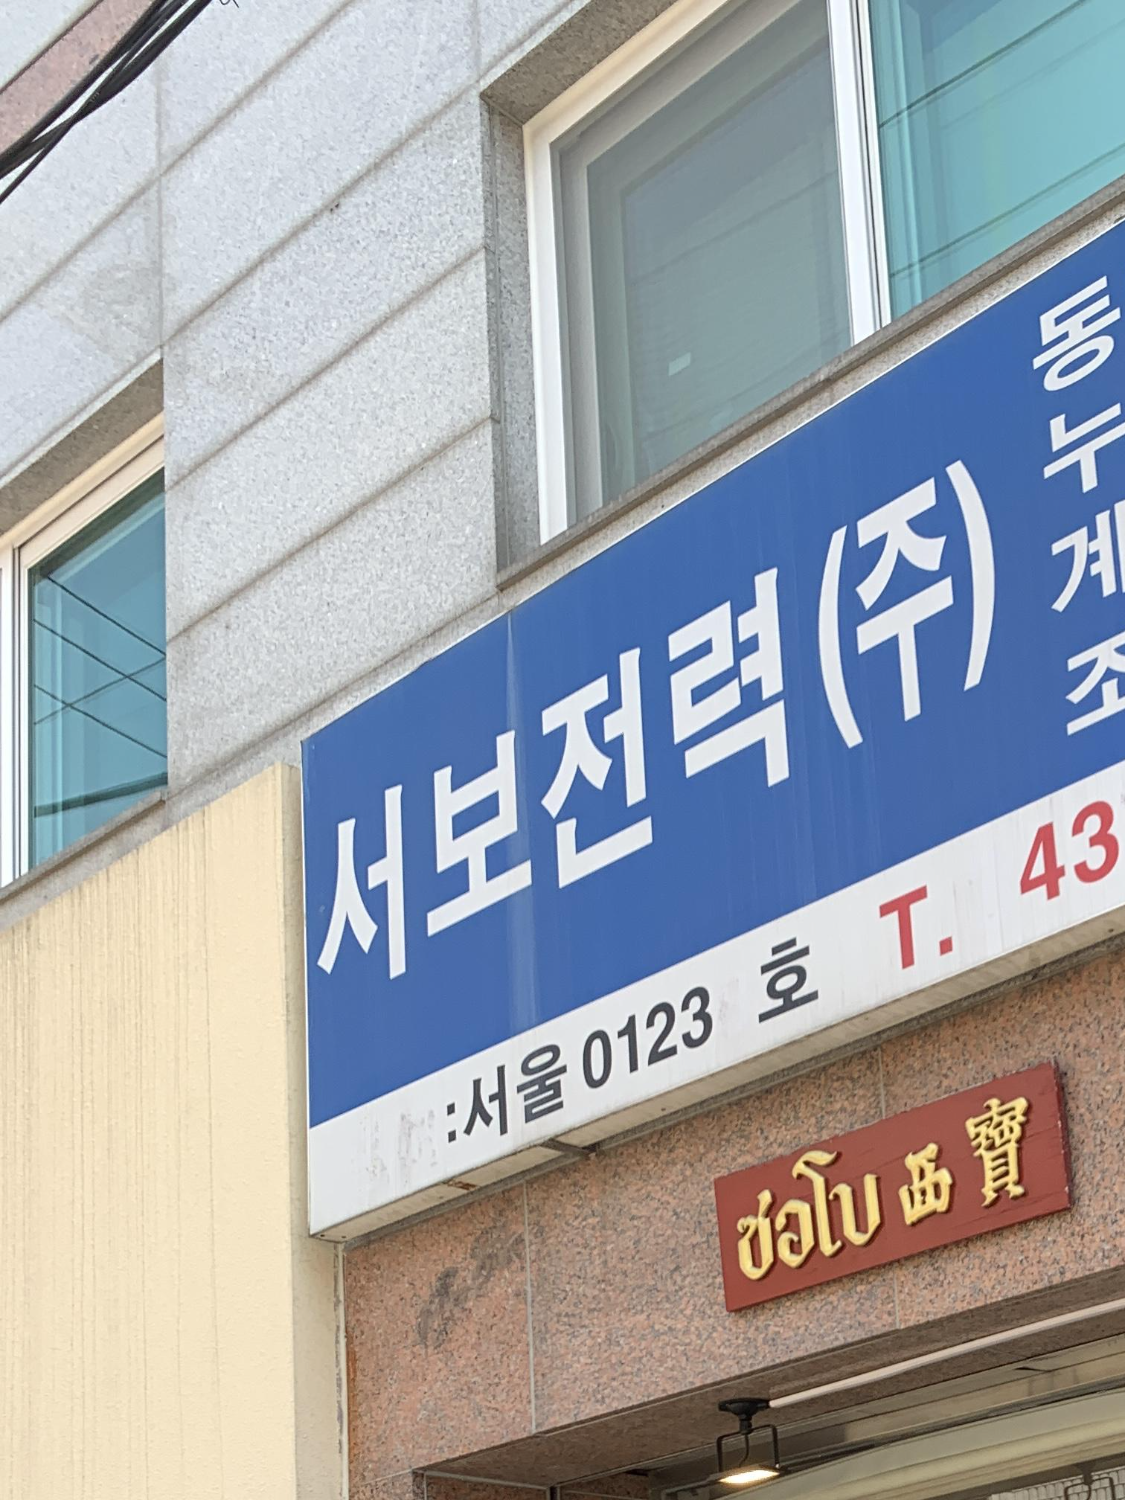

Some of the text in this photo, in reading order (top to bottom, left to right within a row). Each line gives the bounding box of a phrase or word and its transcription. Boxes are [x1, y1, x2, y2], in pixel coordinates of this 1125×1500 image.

[316, 459, 997, 981] 서보전력(주)
[582, 986, 714, 1090] 0123
[757, 936, 819, 1025] 호
[878, 885, 954, 972] T.
[1018, 799, 1121, 901] 43
